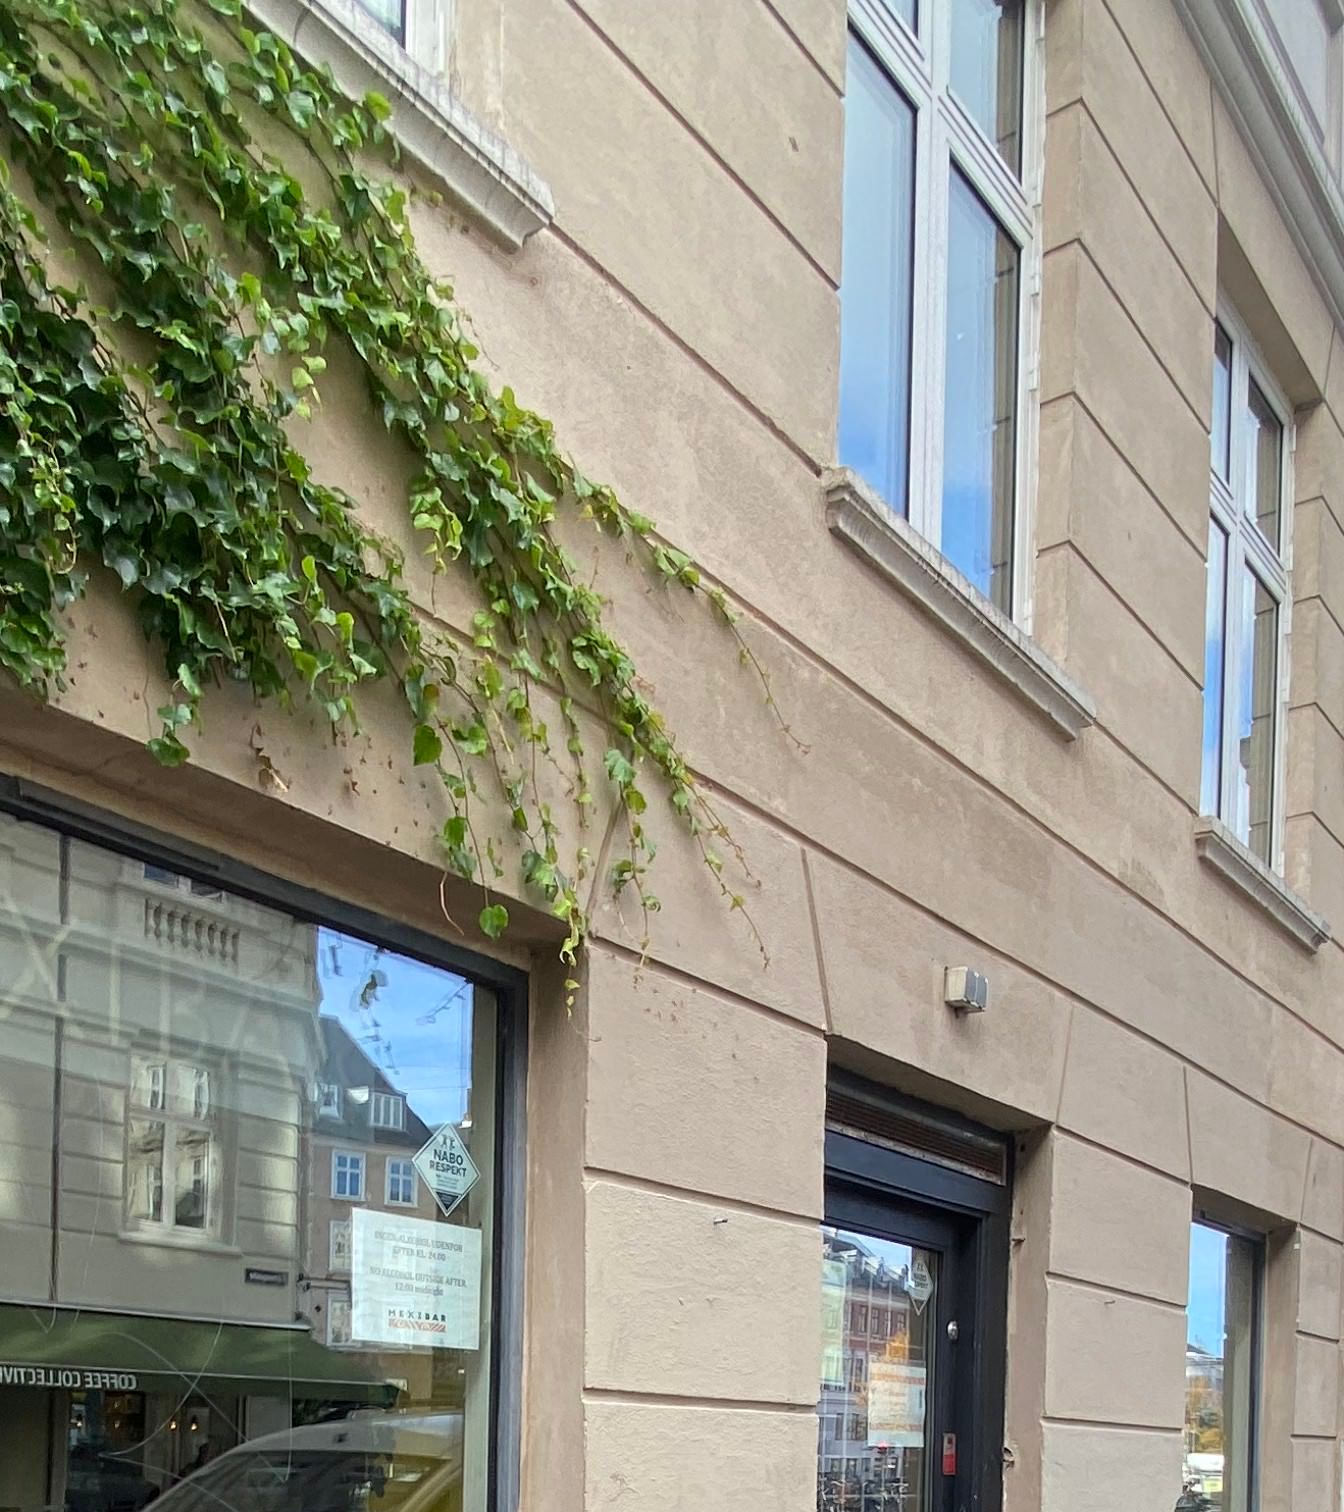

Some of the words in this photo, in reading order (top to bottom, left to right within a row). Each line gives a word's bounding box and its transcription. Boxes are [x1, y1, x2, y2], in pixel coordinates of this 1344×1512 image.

[433, 1149, 463, 1165] NABO
[429, 1160, 466, 1177] RESPEKT
[392, 1246, 415, 1257] EFTER
[432, 1239, 463, 1252] UDENFOR
[370, 1265, 381, 1276] NO
[381, 1267, 414, 1281] ALCOHOL
[415, 1272, 444, 1284] OUTSIDE
[445, 1276, 468, 1288] AFTER
[388, 1309, 447, 1322] MEXIBAR
